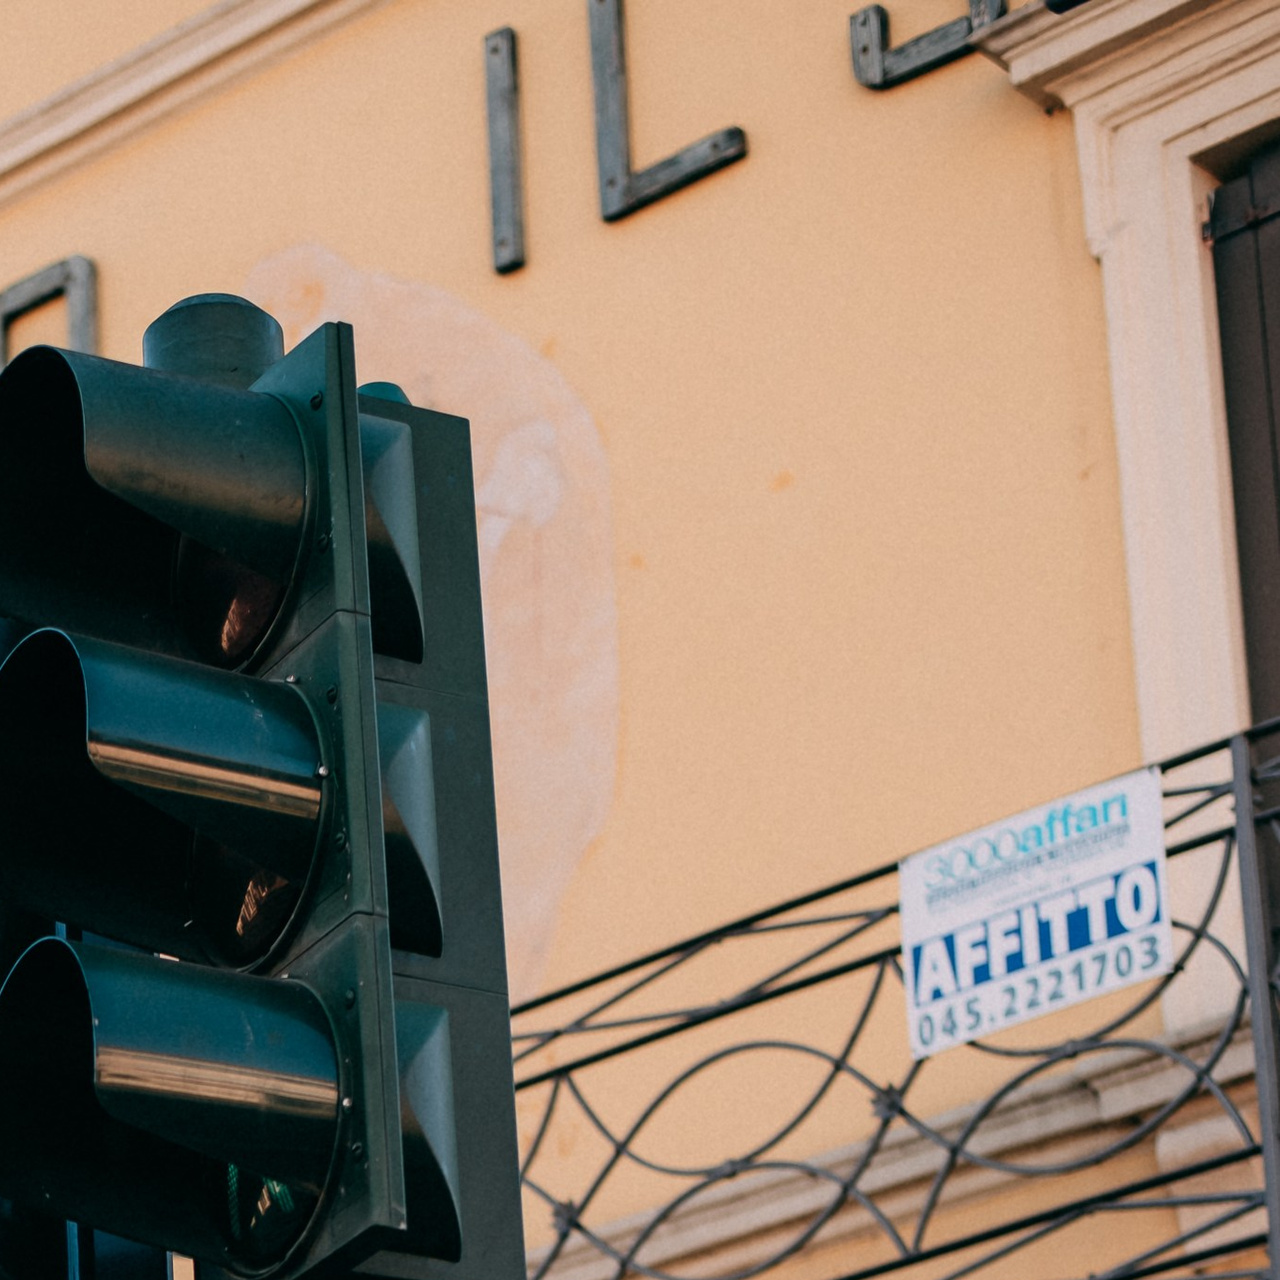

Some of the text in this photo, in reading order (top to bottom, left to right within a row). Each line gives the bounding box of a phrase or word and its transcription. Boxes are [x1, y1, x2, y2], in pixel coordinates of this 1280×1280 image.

[485, 0, 748, 274] IL
[914, 864, 1159, 1006] AFFITTO
[918, 935, 1161, 1046] 045.2221703
